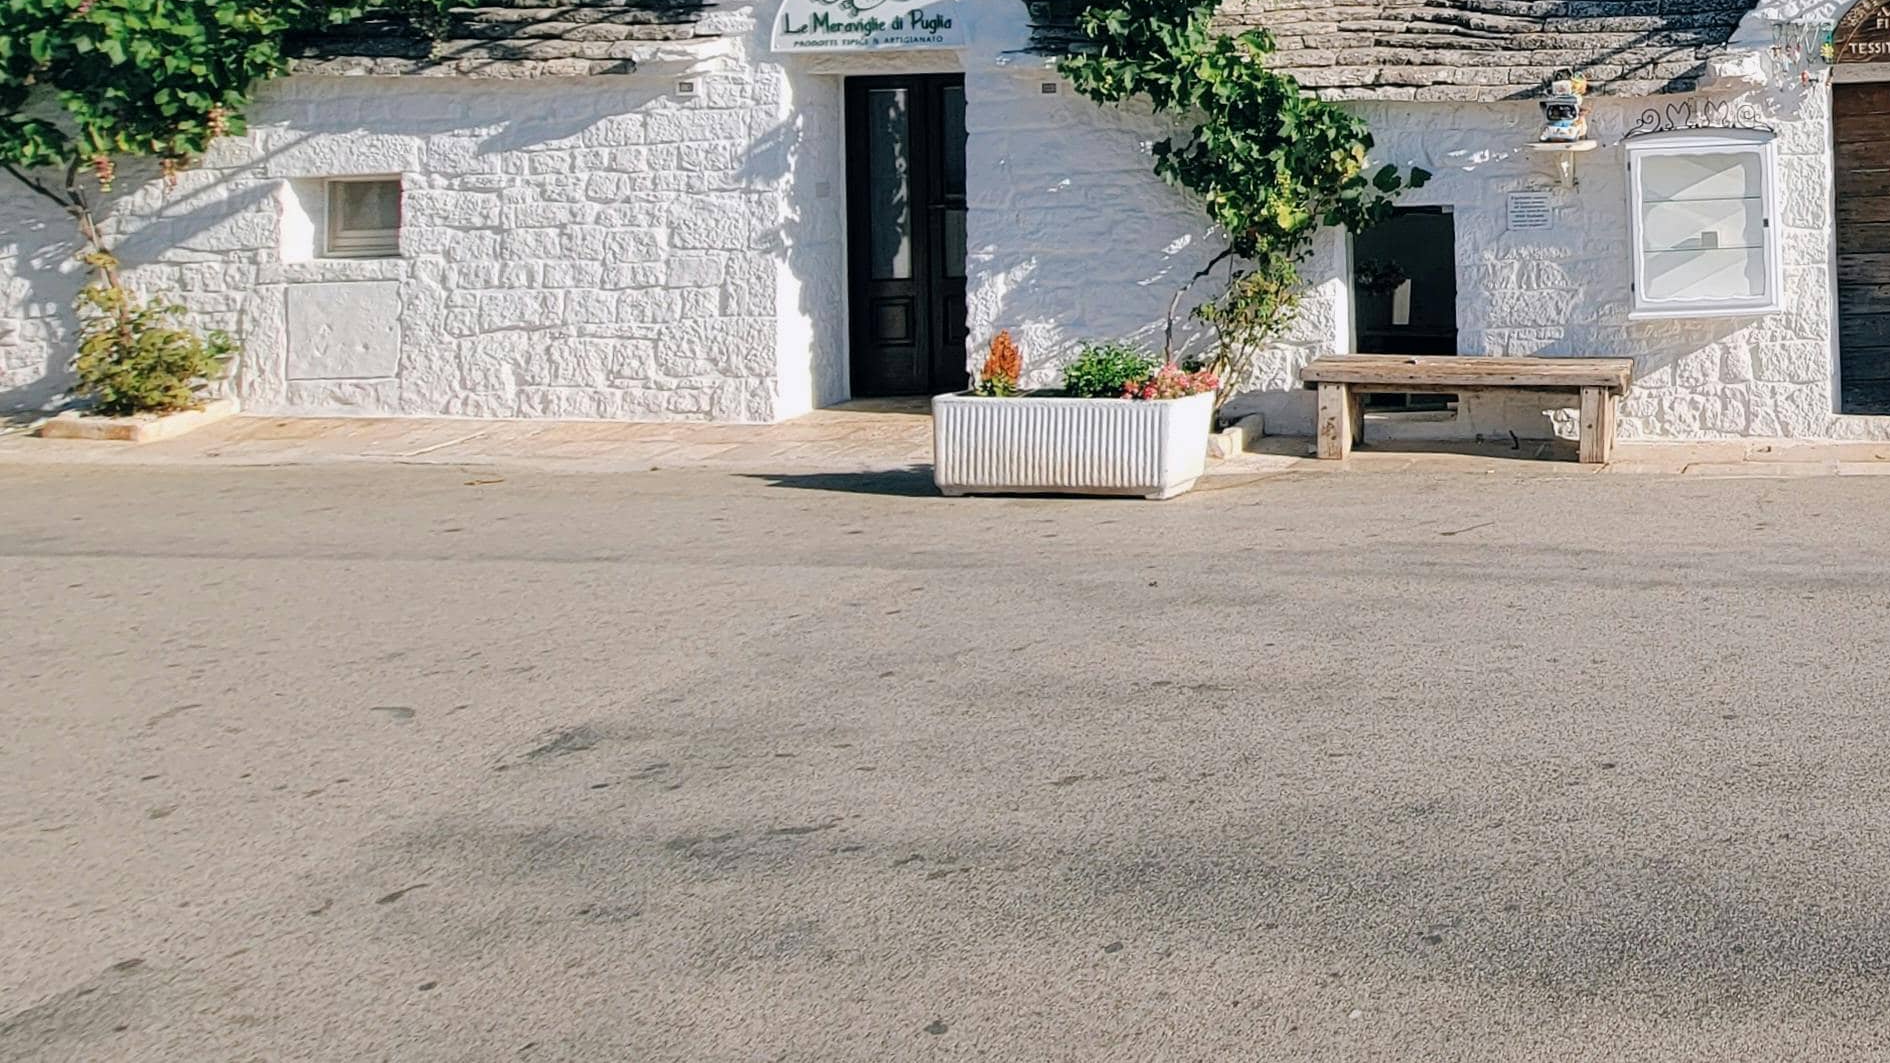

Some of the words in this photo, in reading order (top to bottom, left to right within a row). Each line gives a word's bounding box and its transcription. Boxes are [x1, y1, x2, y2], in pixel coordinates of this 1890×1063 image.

[784, 12, 809, 35] Le
[812, 11, 886, 37] Meraviglie
[891, 15, 904, 31] di
[907, 8, 953, 35] Puglia
[793, 39, 838, 48] PRODOTTI
[884, 35, 944, 44] ARTIGIANATO
